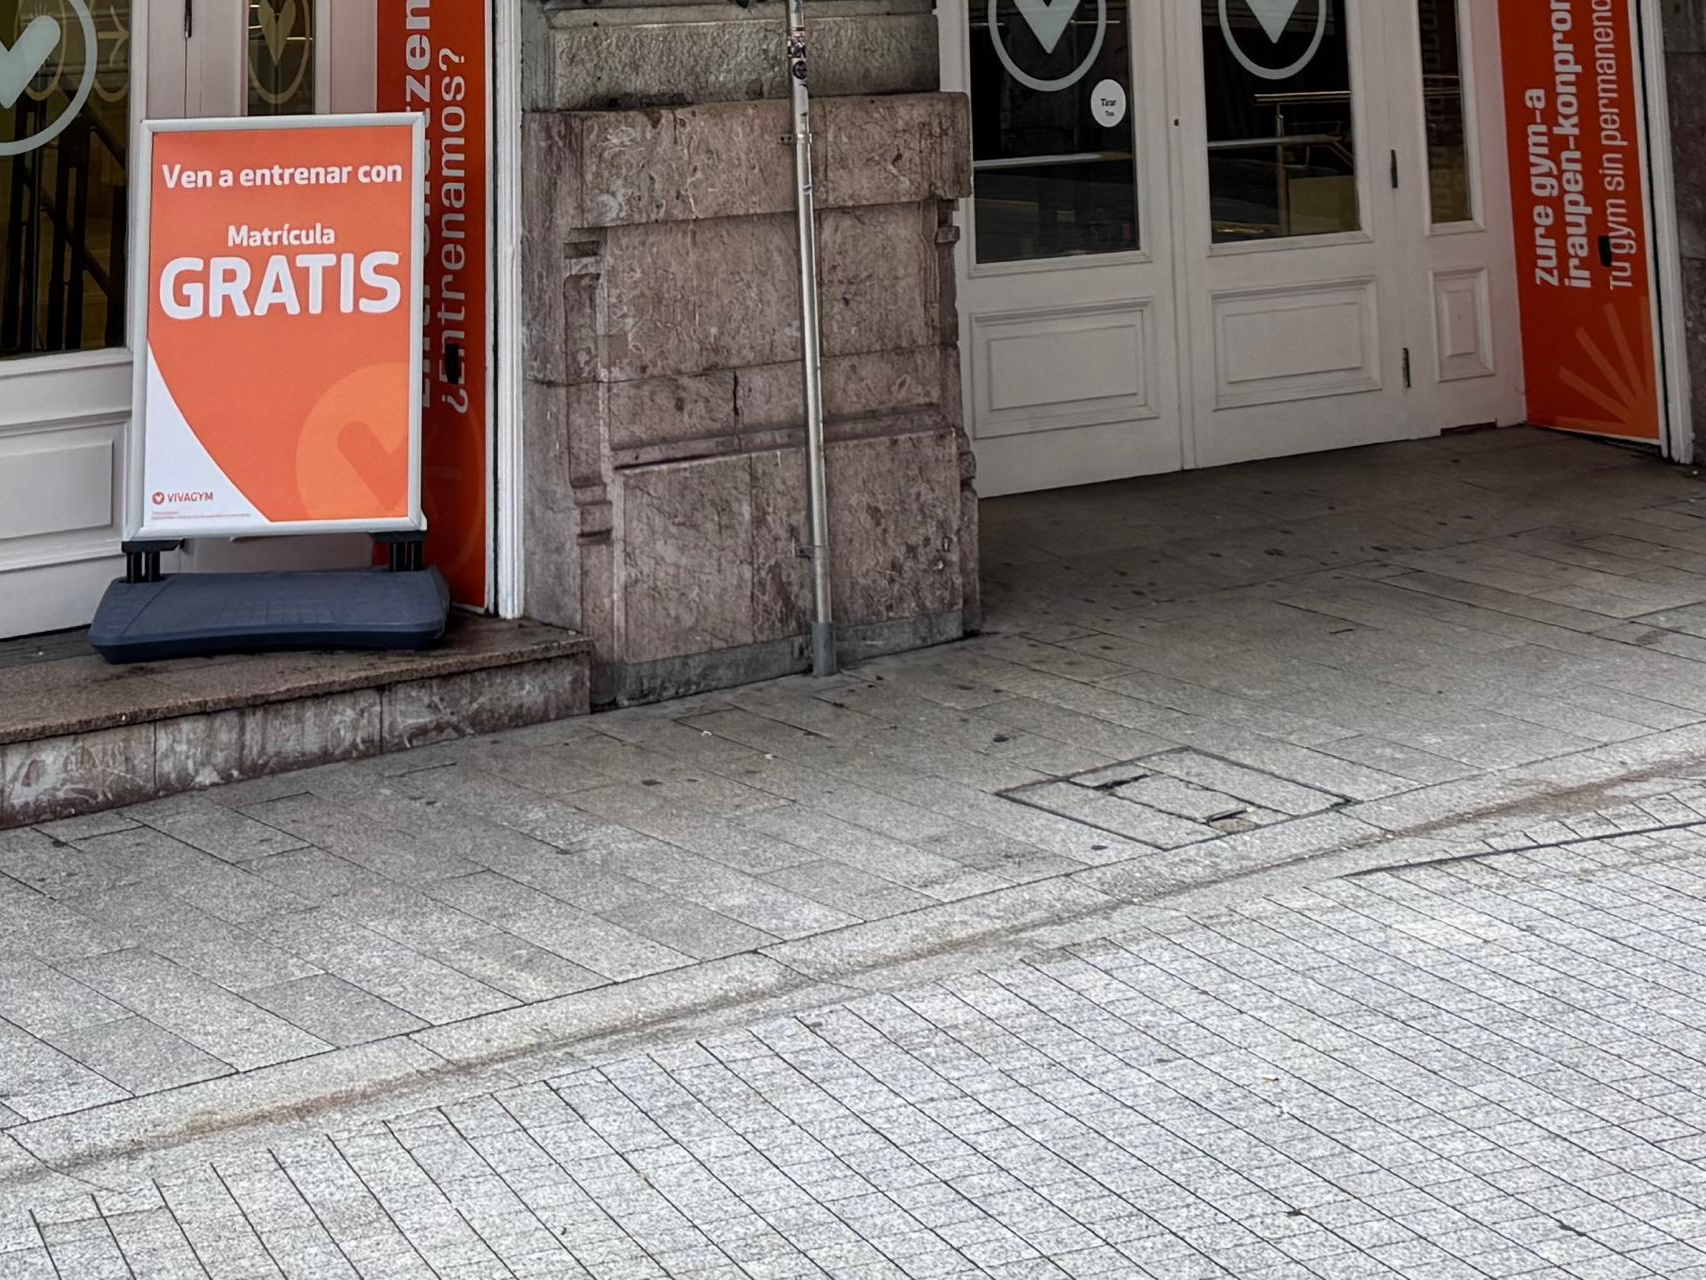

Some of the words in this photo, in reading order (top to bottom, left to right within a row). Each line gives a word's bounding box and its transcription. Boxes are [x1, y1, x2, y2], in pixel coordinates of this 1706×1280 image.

[1524, 88, 1559, 198] gym-a
[162, 163, 213, 189] Ven
[218, 168, 234, 188] a
[239, 164, 353, 187] entrenar
[357, 163, 403, 184] con
[1598, 152, 1626, 191] sin
[227, 222, 335, 248] Matrícula
[1605, 198, 1637, 255] gym
[159, 250, 402, 321] GRATIS
[1609, 260, 1634, 291] Tu
[167, 491, 214, 503] VIVAGYM
